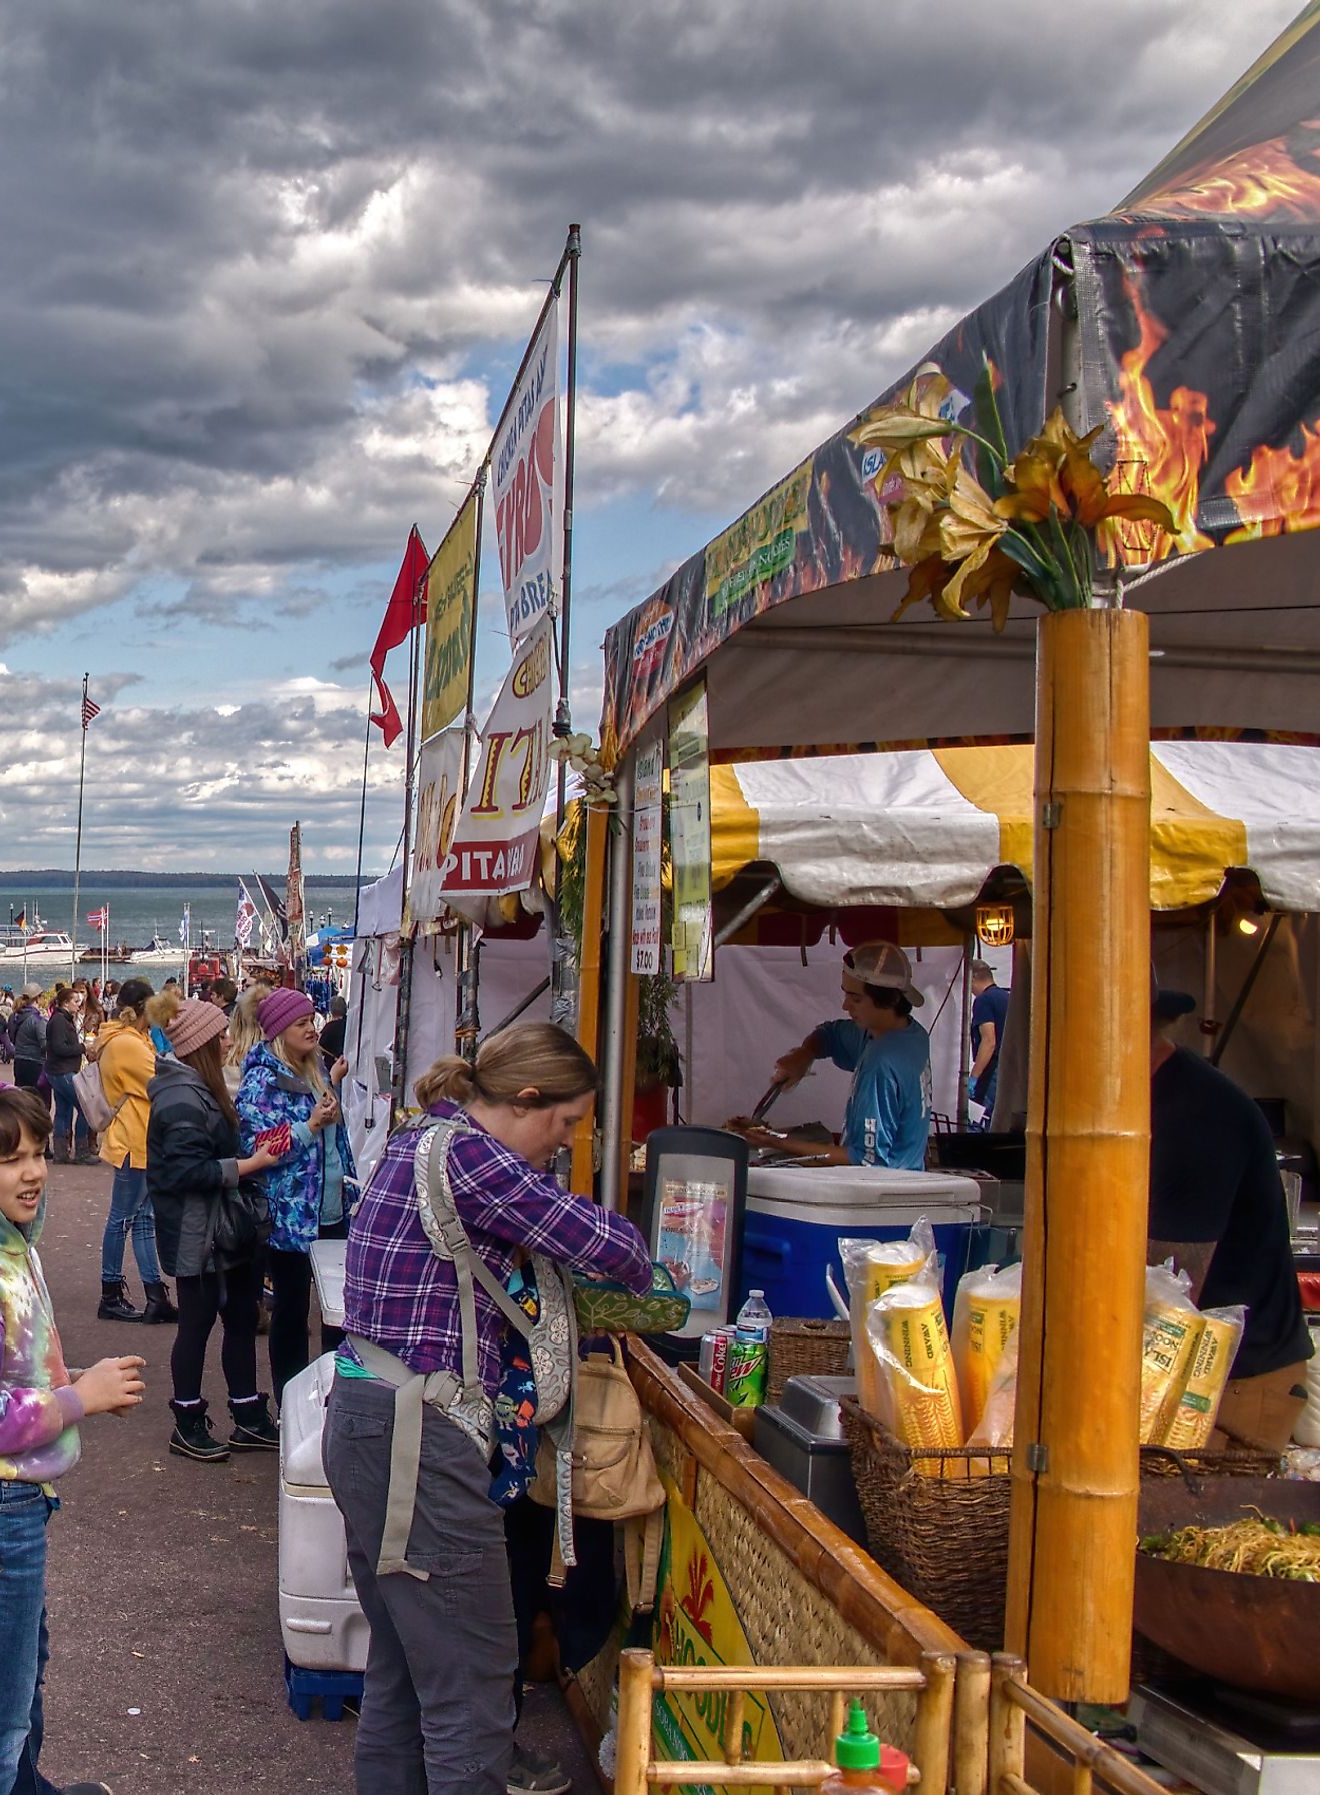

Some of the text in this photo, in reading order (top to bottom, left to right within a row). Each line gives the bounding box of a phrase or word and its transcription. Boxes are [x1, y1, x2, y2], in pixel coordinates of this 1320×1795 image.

[713, 1343, 727, 1373] Coke
[901, 1320, 913, 1368] WINNING
[920, 1323, 934, 1359] AWARD
[1193, 1330, 1213, 1379] WINNING
[1203, 1337, 1219, 1375] AWARD
